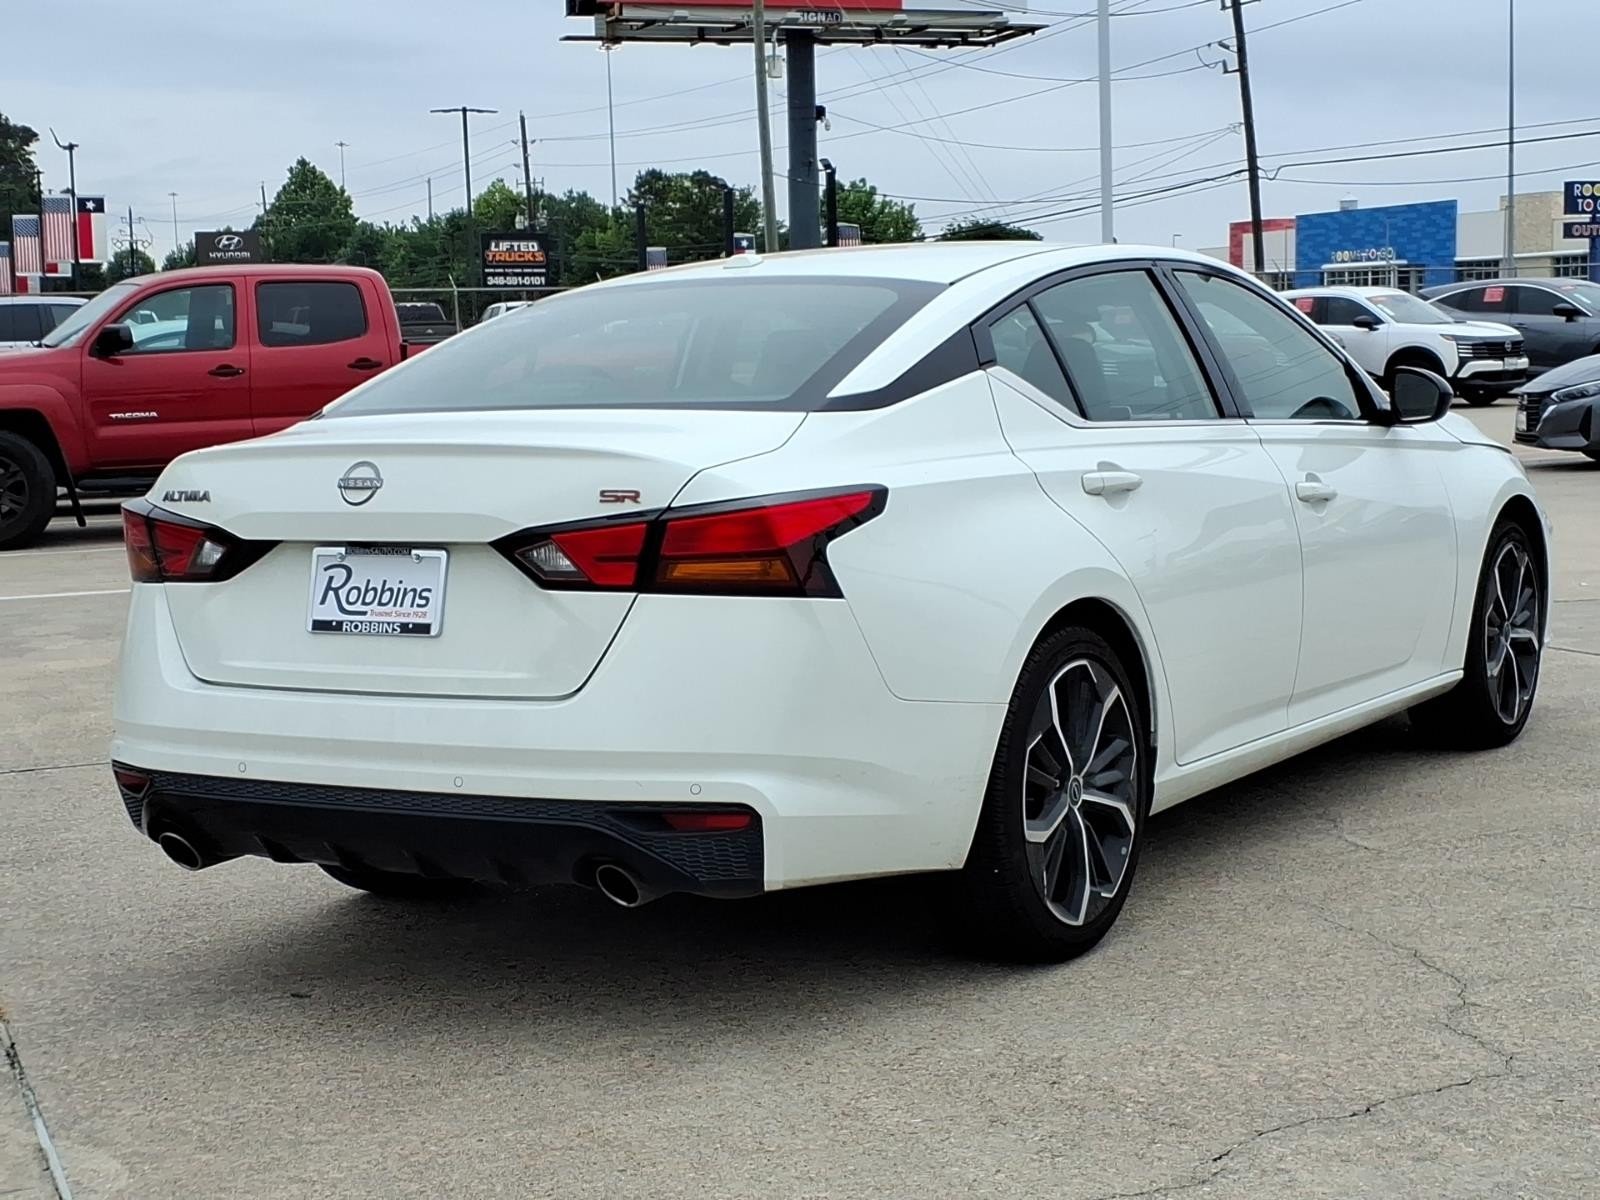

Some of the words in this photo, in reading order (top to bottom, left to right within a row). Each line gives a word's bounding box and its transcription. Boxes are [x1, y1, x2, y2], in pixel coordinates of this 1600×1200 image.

[1577, 199, 1594, 211] TO
[491, 241, 538, 252] LIFTED
[209, 251, 251, 259] HYUNDAI
[486, 251, 545, 263] TRUCKS
[109, 411, 158, 419] TACOMA
[338, 479, 382, 489] NISSAN
[162, 490, 211, 502] ALTIMA
[599, 489, 641, 503] SR
[319, 563, 432, 616] Robbins
[369, 609, 393, 617] Trusted
[394, 610, 411, 618] Since
[342, 621, 401, 634] ROBBINS
